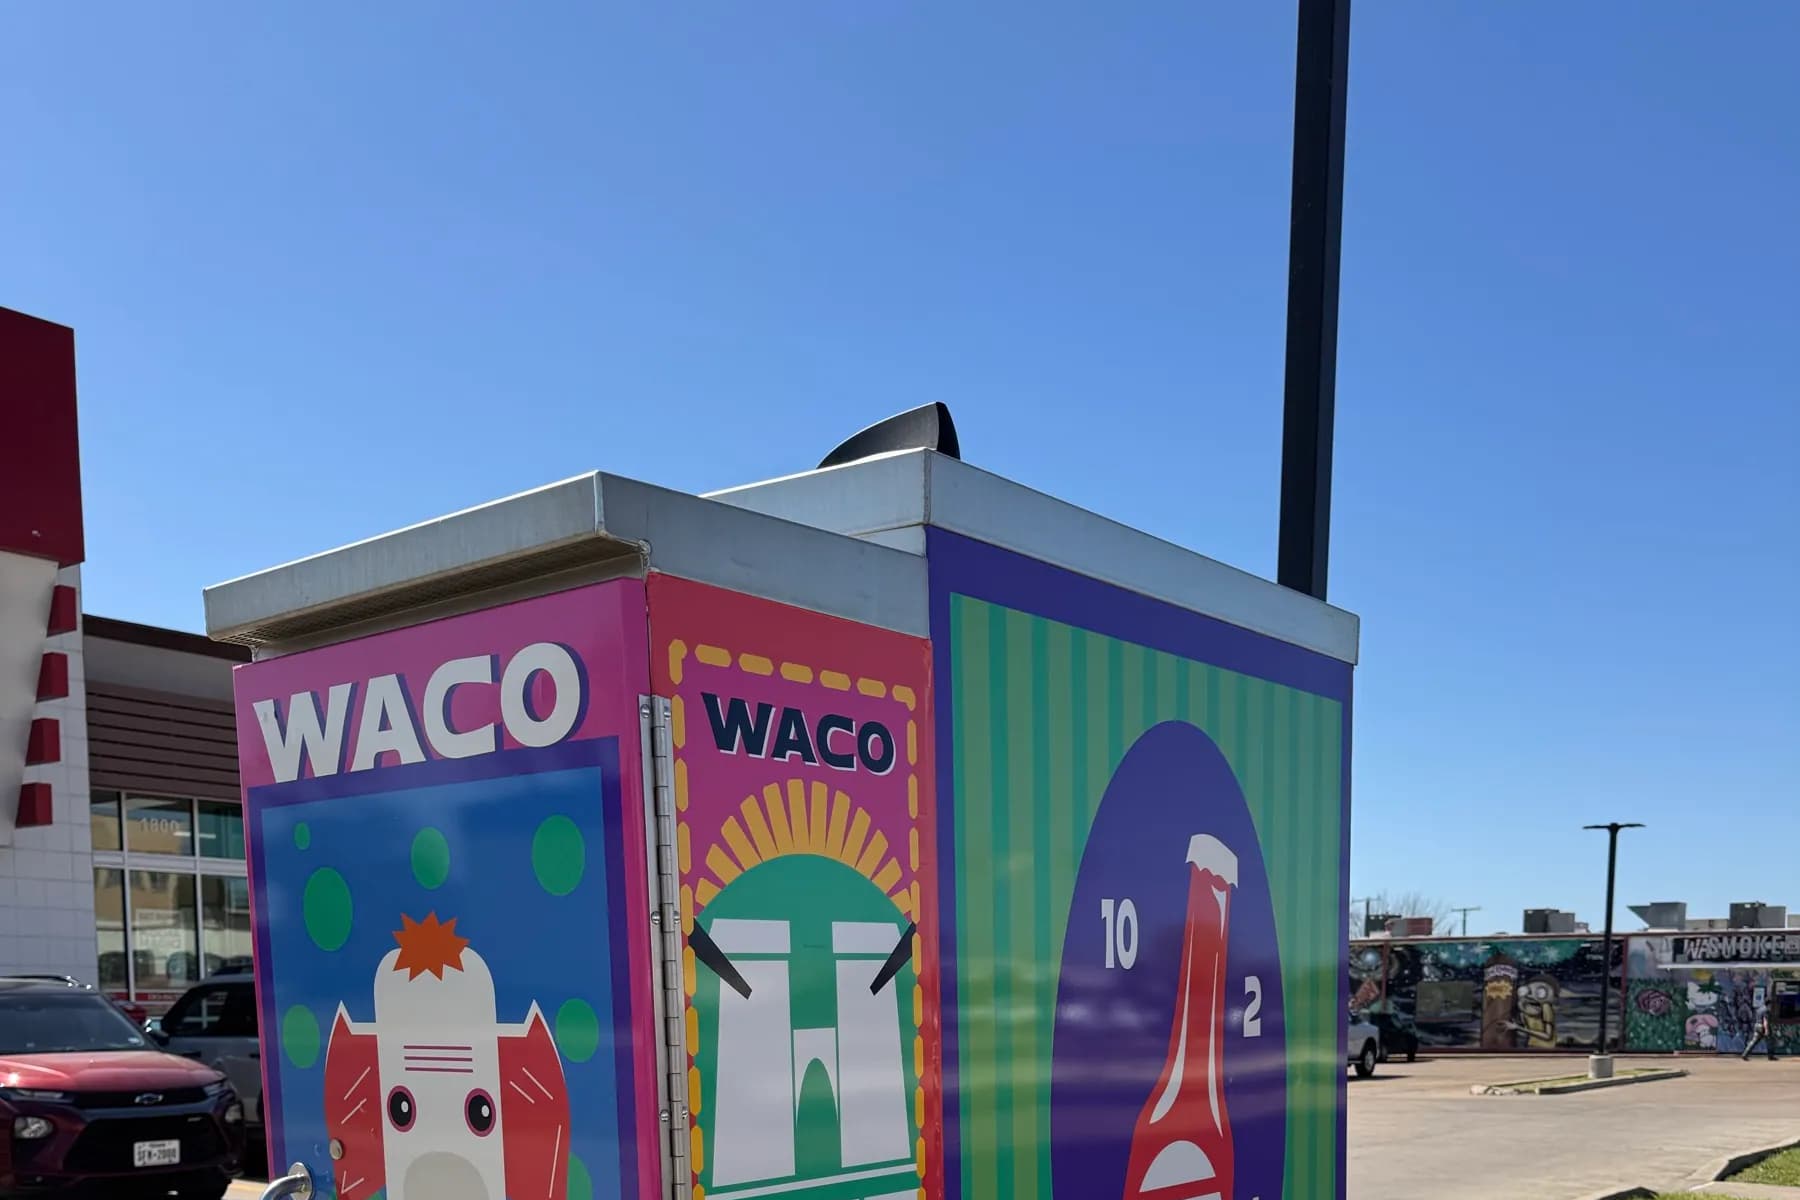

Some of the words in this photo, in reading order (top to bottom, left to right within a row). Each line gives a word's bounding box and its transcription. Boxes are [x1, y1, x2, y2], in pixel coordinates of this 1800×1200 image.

[252, 642, 584, 784] WACO
[701, 692, 896, 776] WACO
[1101, 898, 1139, 970] 10
[1243, 975, 1262, 1038] 2
